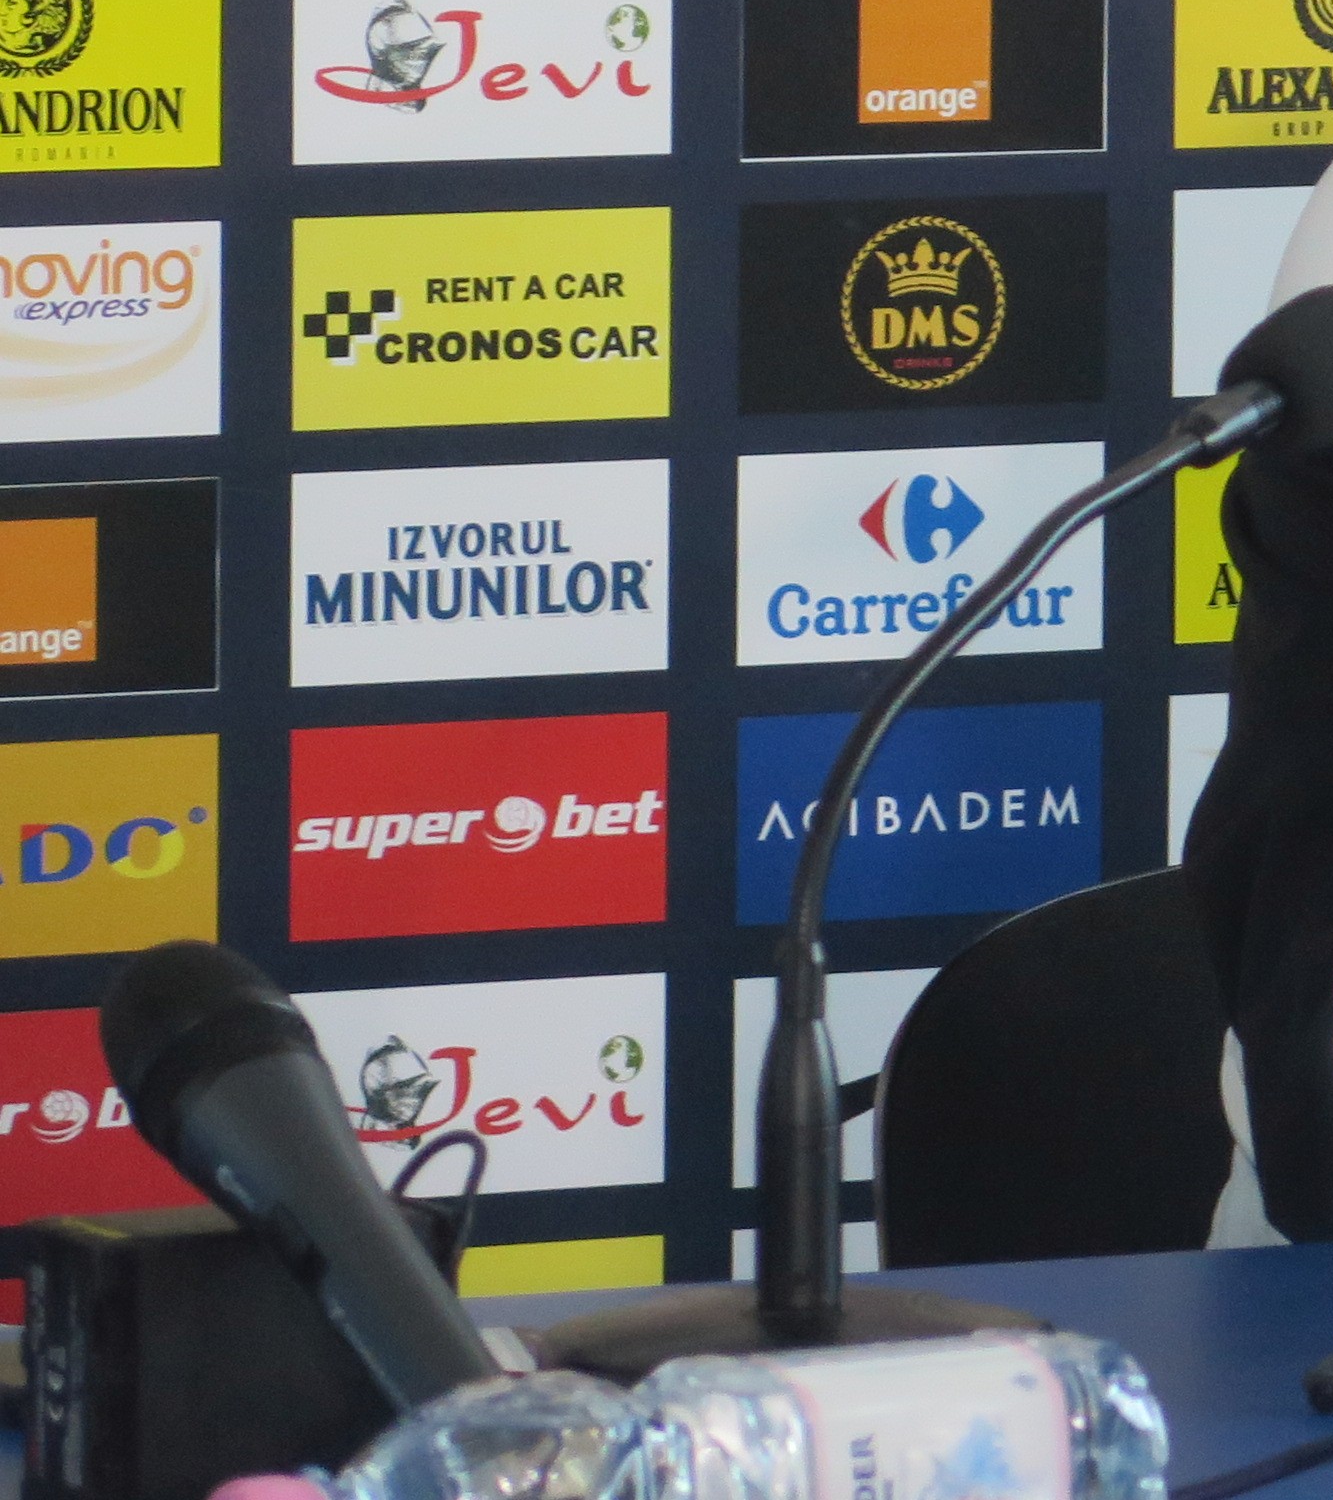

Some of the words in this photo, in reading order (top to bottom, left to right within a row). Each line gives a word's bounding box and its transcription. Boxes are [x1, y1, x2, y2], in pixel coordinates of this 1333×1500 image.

[315, 8, 651, 106] Jevi
[865, 88, 978, 118] orange
[26, 294, 152, 326] express
[427, 276, 516, 303] RENT
[523, 275, 547, 300] A
[555, 273, 624, 300] CAR
[373, 328, 562, 364] CRONOS
[570, 325, 658, 362] CAR
[872, 304, 979, 349] DMS
[389, 520, 570, 560] IZVORUL
[307, 561, 649, 624] MINUNILOR
[768, 570, 1073, 645] Carrefur
[0, 816, 181, 884] DO
[293, 810, 485, 859] super
[552, 790, 663, 838] bet
[347, 1043, 644, 1142] Jevi
